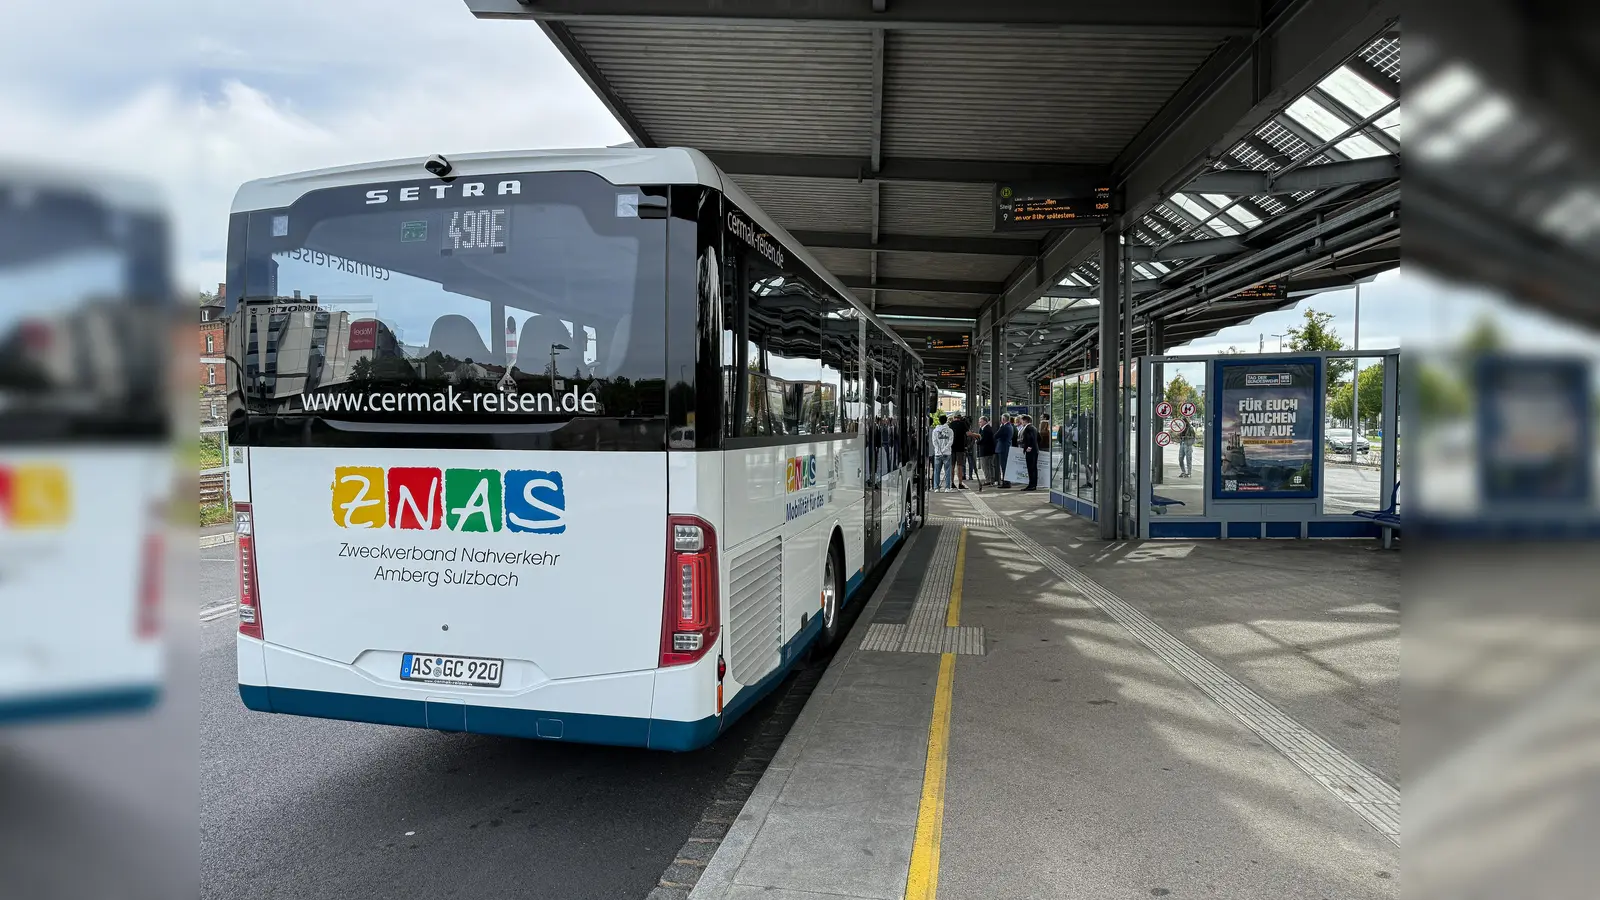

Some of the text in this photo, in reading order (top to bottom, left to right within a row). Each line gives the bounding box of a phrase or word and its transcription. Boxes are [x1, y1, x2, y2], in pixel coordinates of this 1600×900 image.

[366, 180, 521, 204] SETRA
[448, 208, 505, 249] 490E
[1003, 213, 1008, 221] 9
[727, 211, 784, 270] cermak-reisen.de
[301, 385, 597, 414] www.cermak-reisen.de
[1238, 398, 1298, 412] FÜR EUCH
[1240, 412, 1296, 424] TAUCHEN
[1240, 424, 1296, 437] WIR AUF.
[787, 454, 816, 494] ZNAS
[336, 470, 566, 533] ZNAS
[786, 495, 809, 522] Mobilität
[339, 542, 561, 566] Zweckverband Nahverkehr
[374, 566, 519, 587] Amberg Sulzbach
[412, 657, 498, 680] AS GC 920
